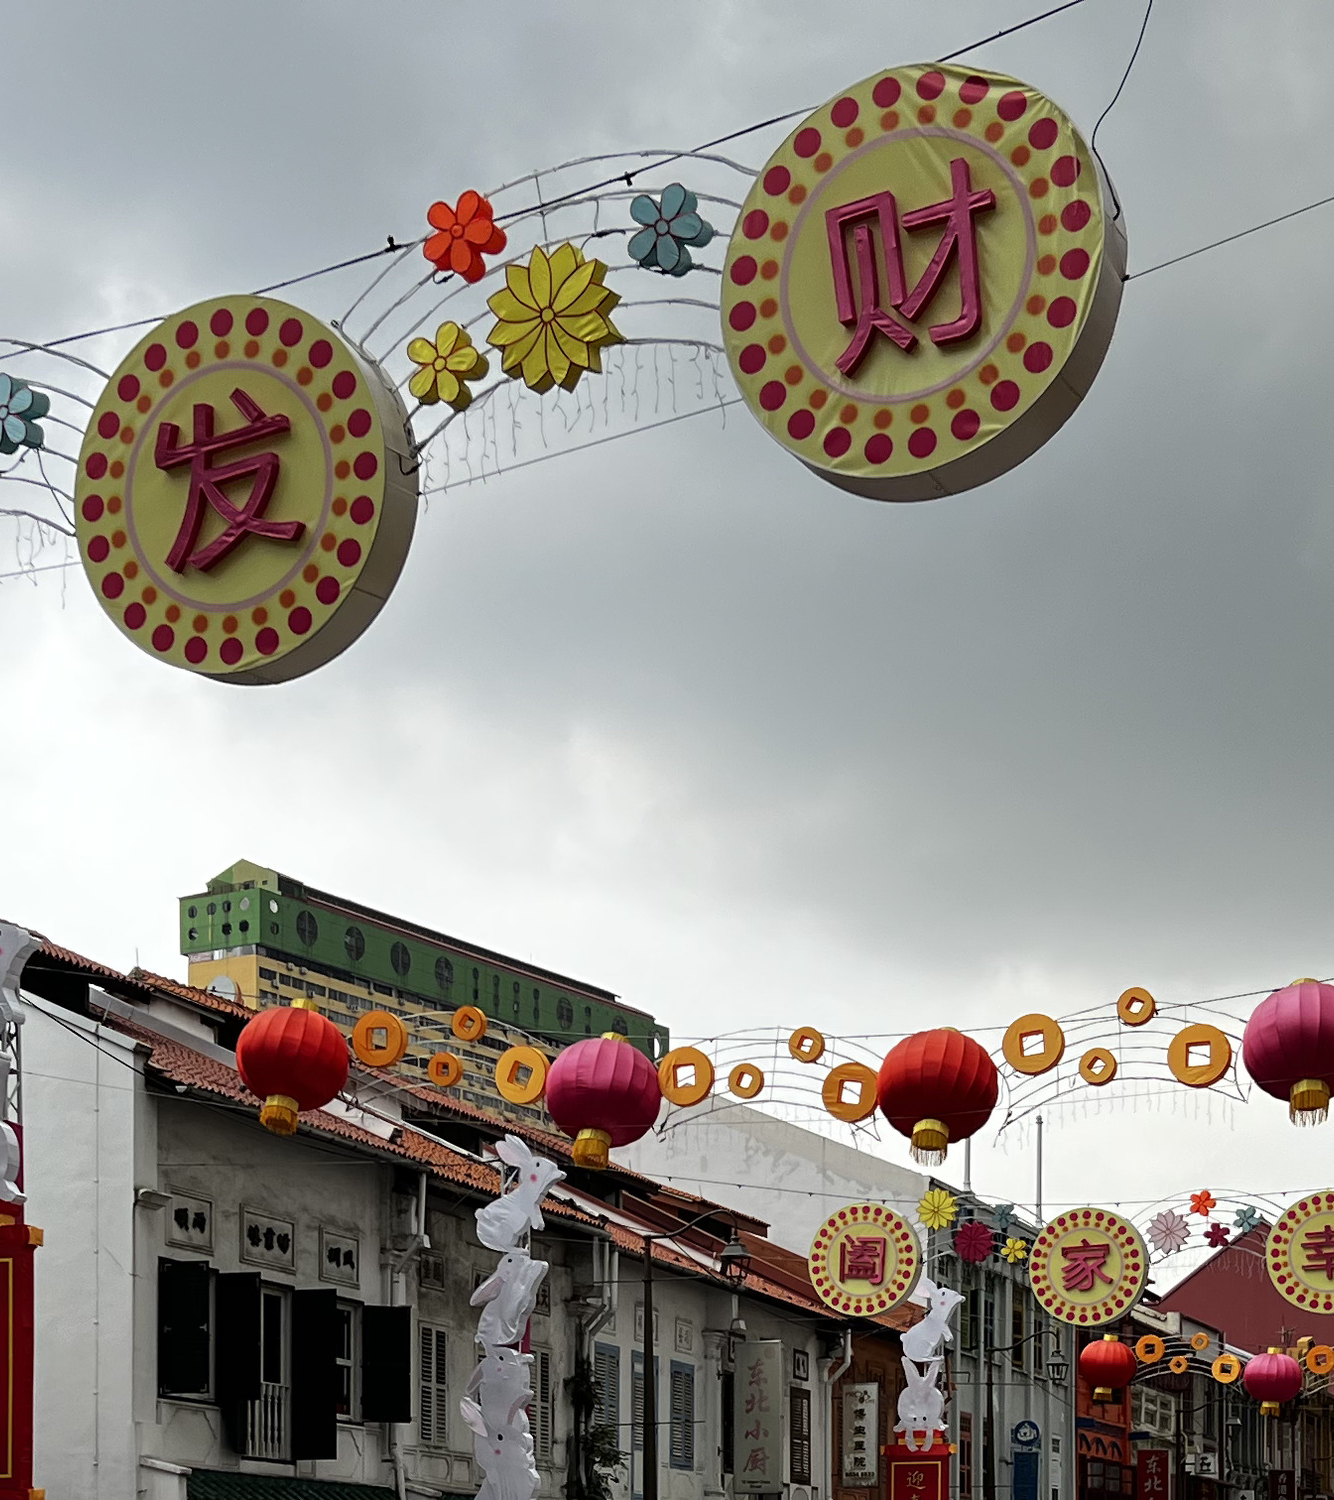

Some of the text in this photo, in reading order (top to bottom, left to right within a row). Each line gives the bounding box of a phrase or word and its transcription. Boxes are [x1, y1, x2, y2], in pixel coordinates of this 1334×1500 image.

[826, 157, 998, 377] 财
[166, 388, 305, 575] 发
[839, 1234, 886, 1285] 阖
[1061, 1238, 1113, 1291] 家
